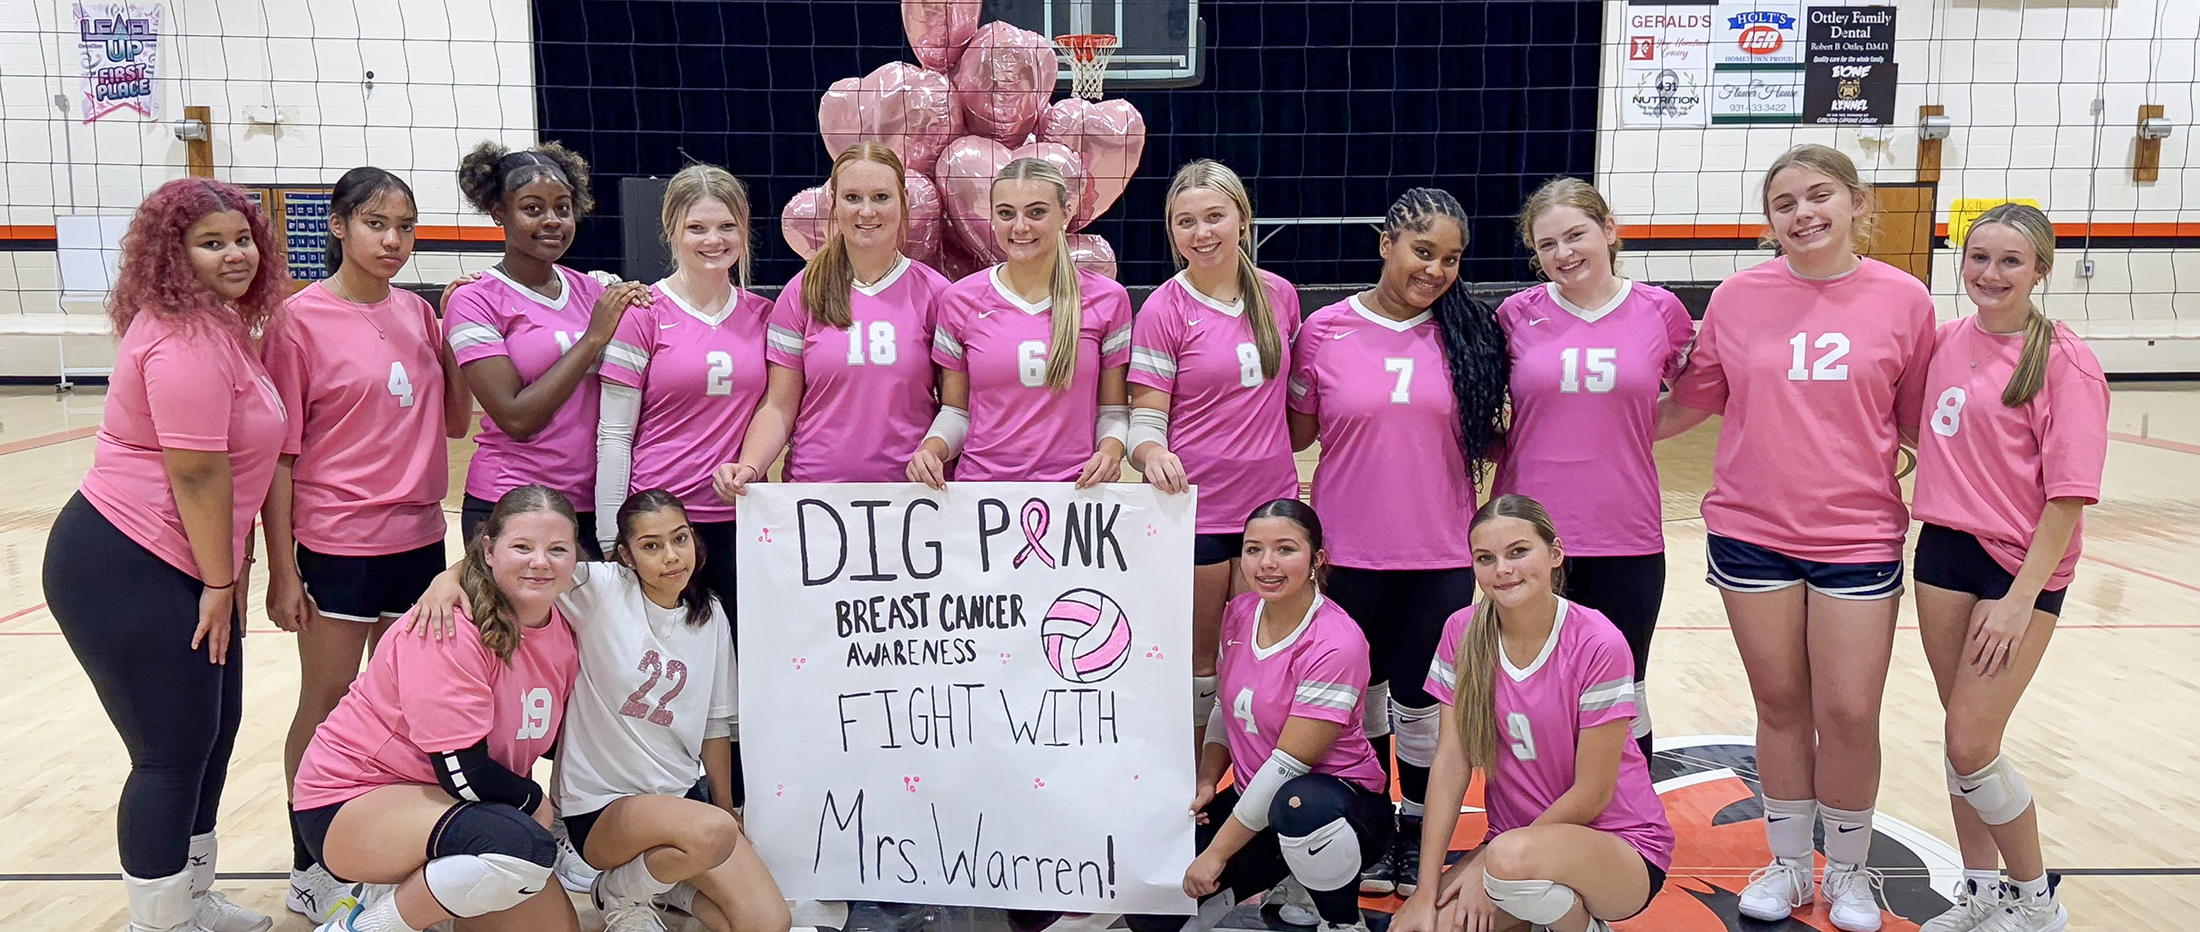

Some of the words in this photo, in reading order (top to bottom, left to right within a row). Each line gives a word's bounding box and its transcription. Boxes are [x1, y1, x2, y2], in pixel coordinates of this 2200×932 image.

[1631, 15, 1712, 28] GERALD'S
[1737, 12, 1787, 24] HOLT'S
[1742, 30, 1780, 49] IGA
[1811, 11, 1849, 25] Ottley
[1852, 11, 1892, 26] Family
[1830, 26, 1871, 39] Dental
[106, 39, 144, 62] UP
[1811, 43, 1833, 51] Robert
[96, 79, 151, 101] PLACE
[98, 63, 146, 84] FIRST
[1718, 84, 1757, 100] Flower
[1758, 84, 1798, 100] House
[1832, 65, 1872, 78] BONE
[1632, 96, 1699, 104] NUTRITION
[1831, 100, 1868, 111] KENNEL
[845, 320, 898, 367] 18
[1016, 340, 1048, 388] 6
[1234, 341, 1265, 388] 8
[1787, 331, 1851, 381] 12
[387, 360, 414, 408] 4
[705, 350, 734, 397] 2
[1384, 356, 1415, 404] 7
[1559, 347, 1617, 394] 15
[1930, 386, 1966, 437] 8
[796, 498, 943, 587] DIG
[835, 591, 931, 638] BREAST
[939, 594, 1027, 631] CANCER
[846, 637, 977, 668] AWARENESS
[619, 649, 688, 727] 22
[1232, 685, 1260, 735] 4
[515, 687, 553, 740] 19
[838, 683, 985, 752] FIGHT
[999, 688, 1119, 747] WITH
[1506, 711, 1537, 761] 9
[814, 788, 927, 886] Mrs.
[930, 801, 1117, 900] Warren!
